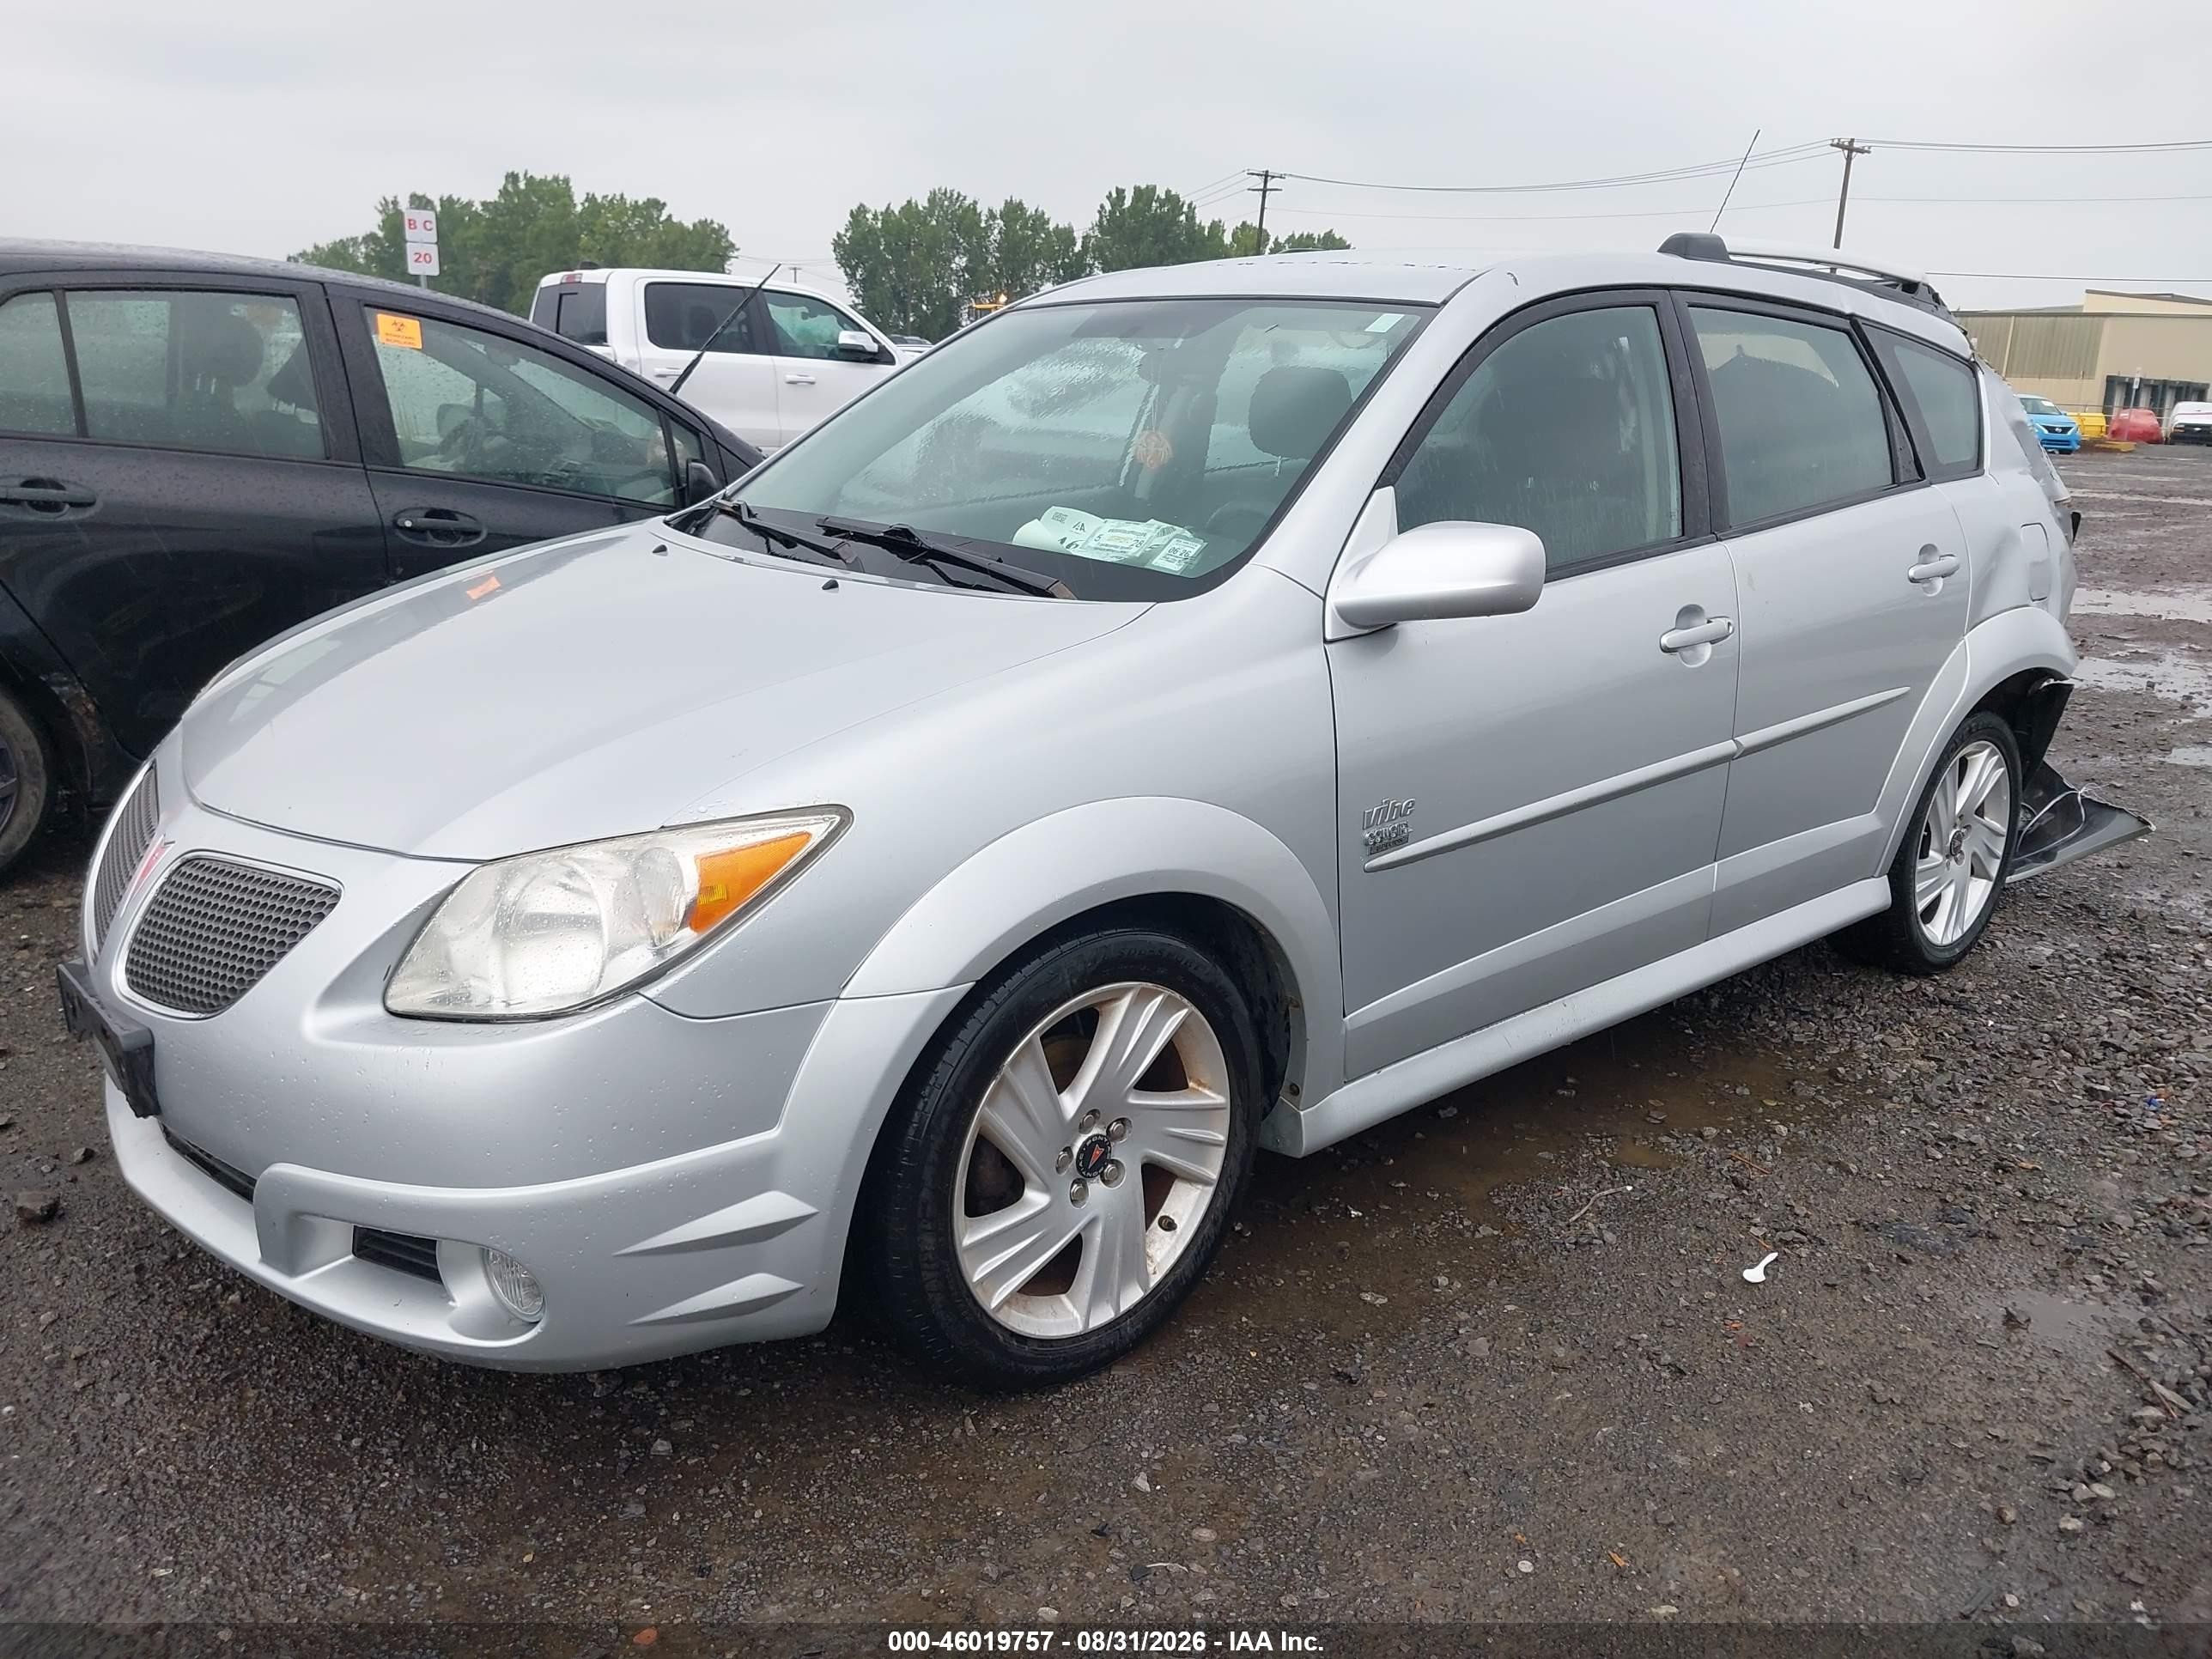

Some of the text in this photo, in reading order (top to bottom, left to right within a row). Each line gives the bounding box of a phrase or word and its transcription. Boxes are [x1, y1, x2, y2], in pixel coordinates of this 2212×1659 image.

[408, 218, 434, 231] B C
[413, 252, 433, 264] 20
